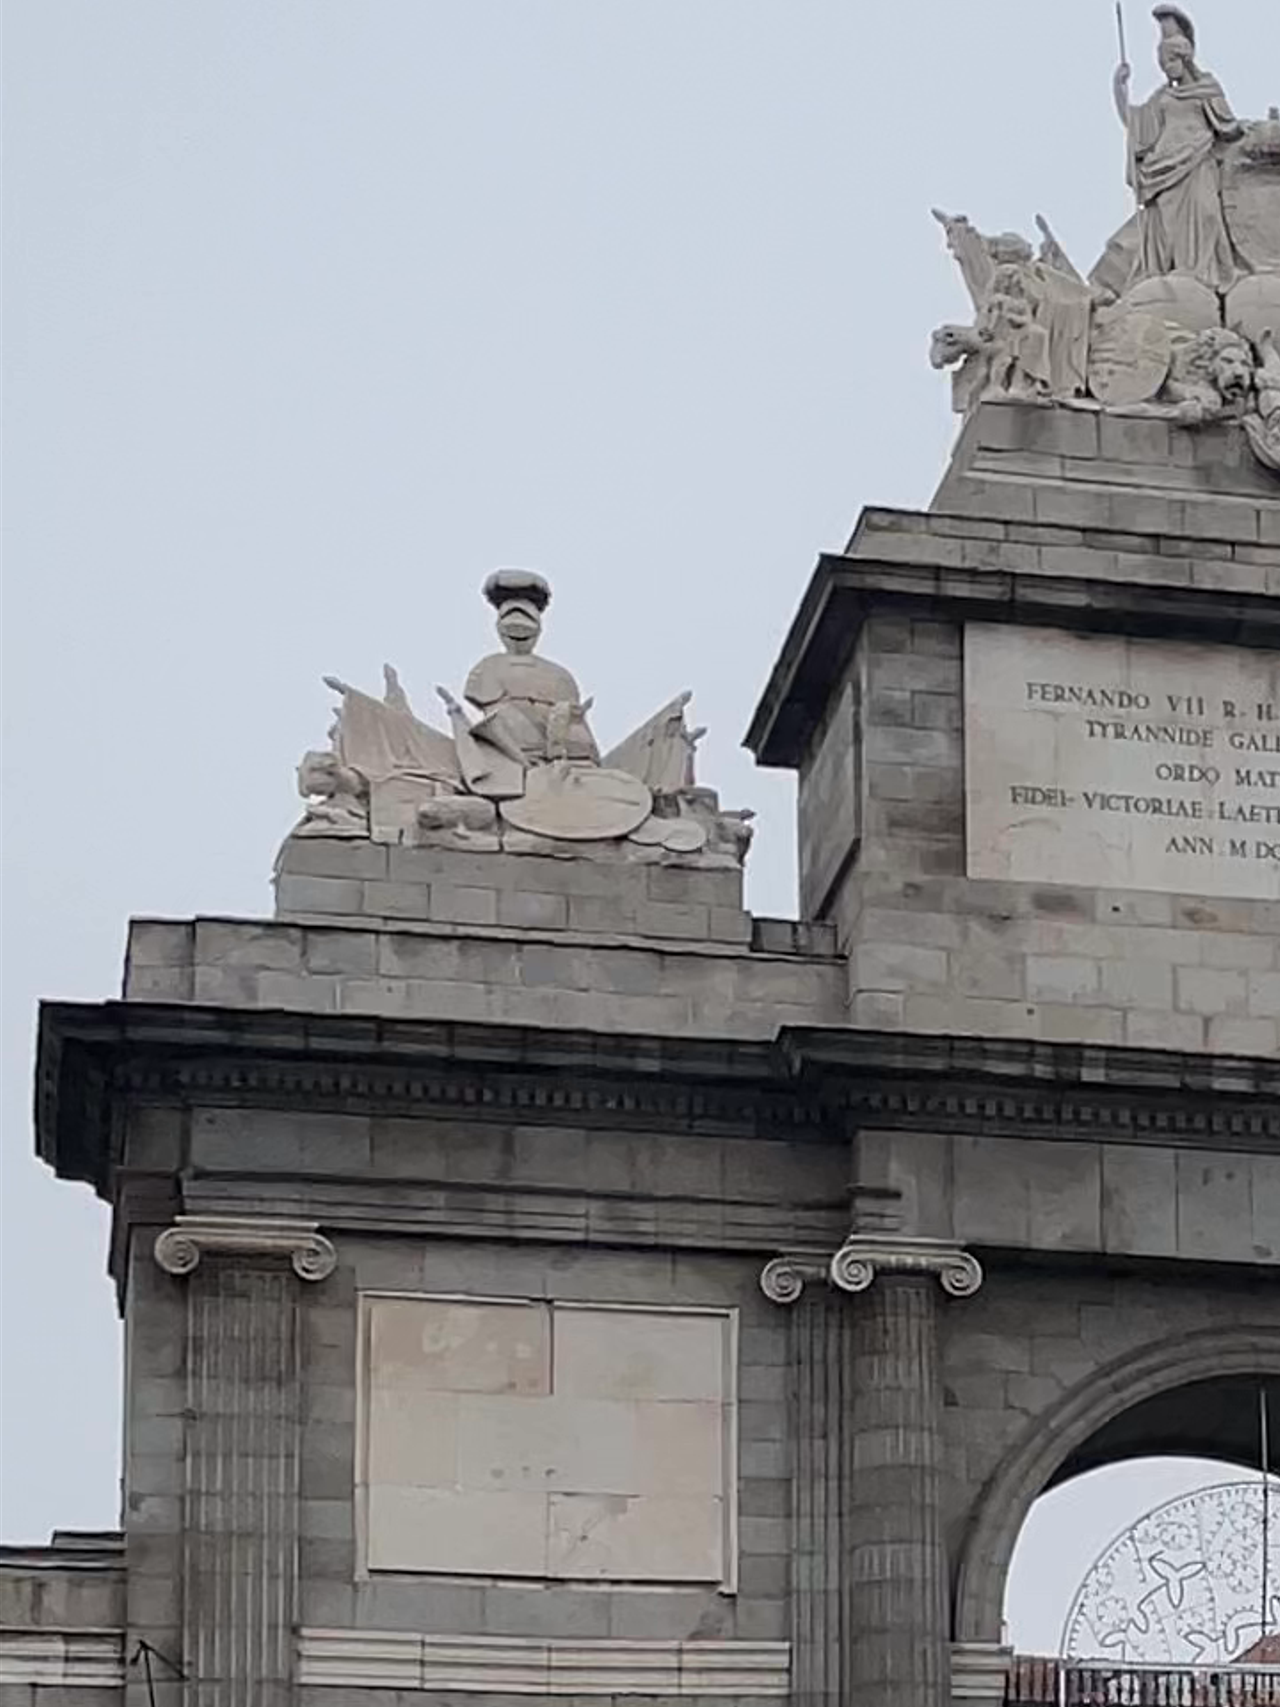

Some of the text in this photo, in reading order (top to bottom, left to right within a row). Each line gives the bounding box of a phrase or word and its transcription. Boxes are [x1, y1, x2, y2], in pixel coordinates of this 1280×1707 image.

[1026, 682, 1150, 709] FERNANDO
[1167, 695, 1204, 716] VII
[1086, 719, 1214, 748] TYRANNIDE
[1155, 763, 1220, 787] ORDO
[1082, 791, 1203, 819] VICTORIAE
